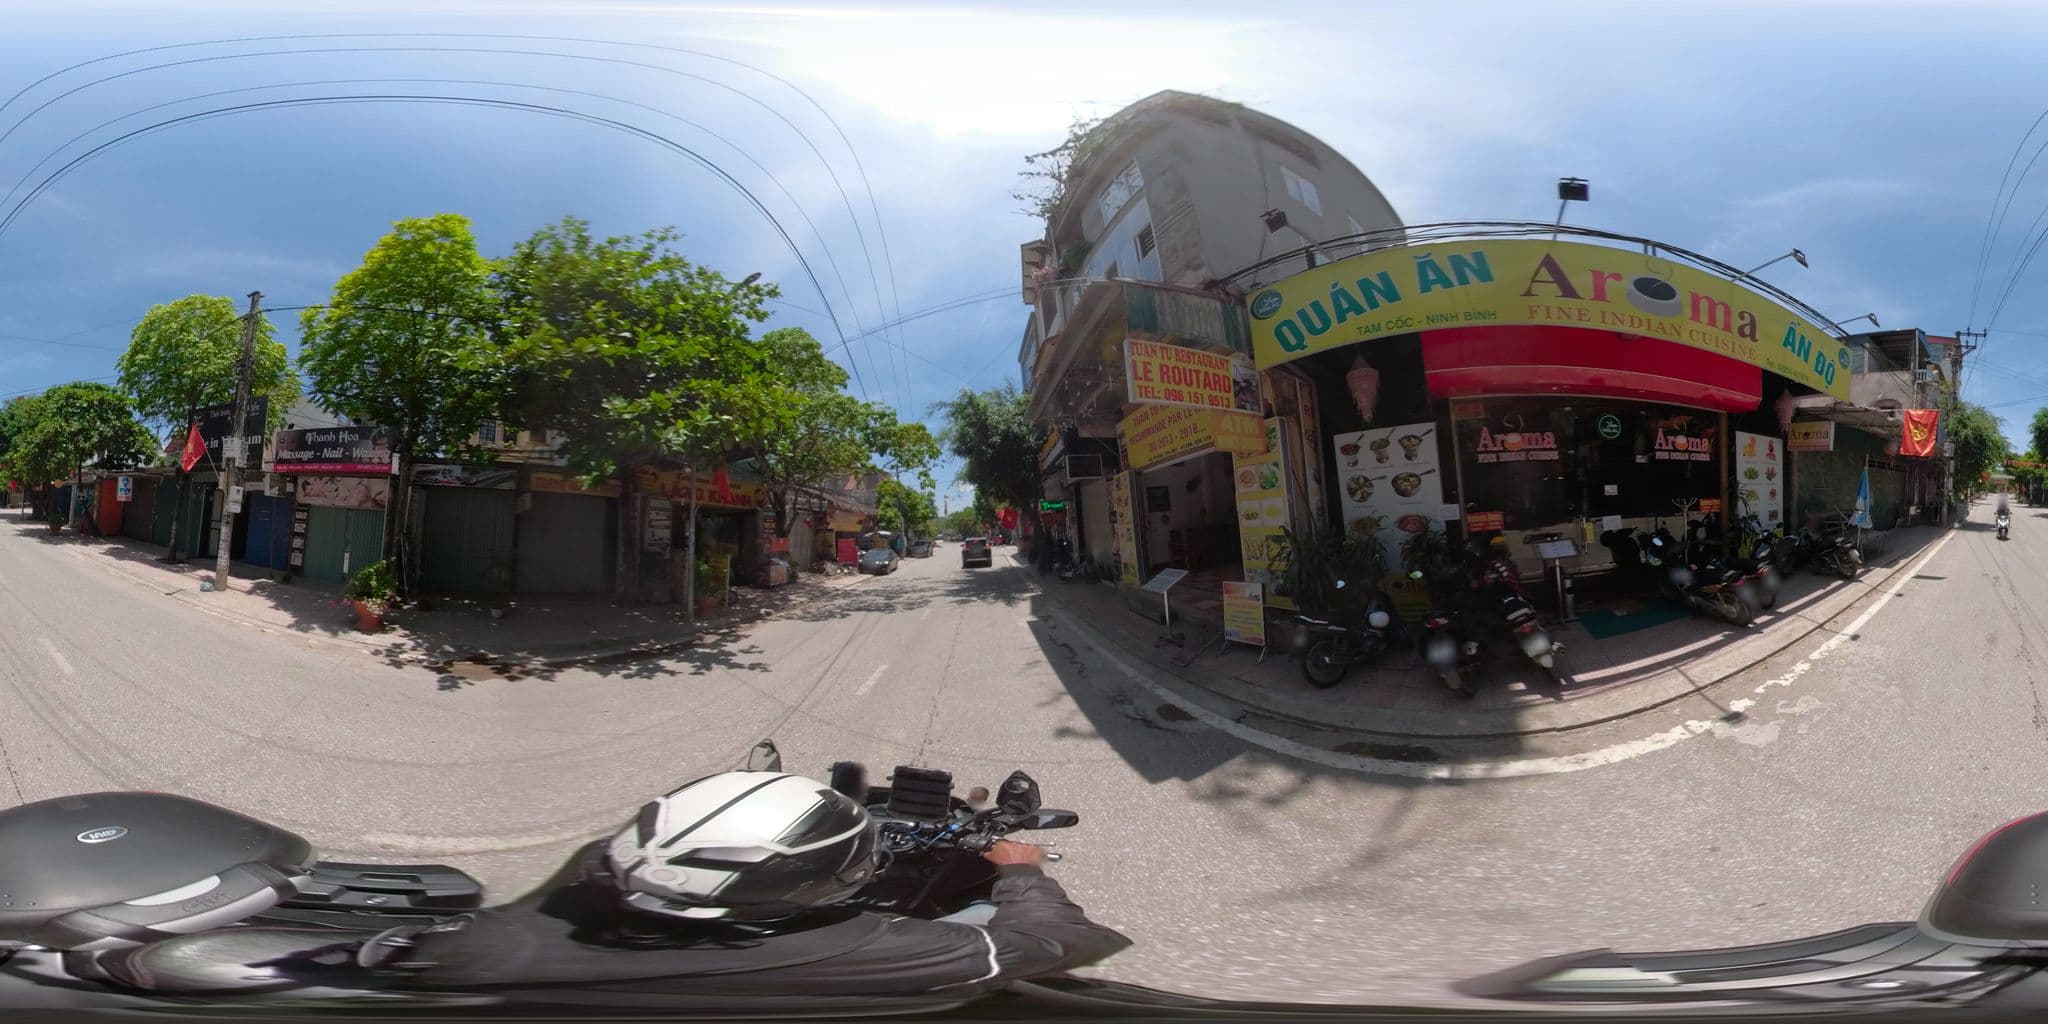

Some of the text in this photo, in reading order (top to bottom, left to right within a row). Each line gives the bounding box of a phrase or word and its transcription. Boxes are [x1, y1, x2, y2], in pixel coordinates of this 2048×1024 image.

[1273, 251, 1495, 353] QUÁN ĂN
[1519, 252, 1759, 343] Aroma
[1356, 322, 1381, 336] TAM
[1426, 313, 1459, 325] NINH
[1528, 304, 1757, 360] FINE INDIAN CUISINE
[1129, 341, 1157, 359] TUAN
[1159, 345, 1173, 360] TU
[1174, 348, 1229, 372] RESTAURANT
[1782, 321, 1812, 364] ẤN
[1814, 350, 1836, 389] ĐỘ
[1130, 359, 1153, 382] LE
[1159, 363, 1232, 394] ROUTARD
[1136, 384, 1161, 399] TEL:
[1222, 416, 1259, 434] ATM
[1789, 427, 1829, 440] Aroma
[305, 432, 336, 445] Thanh
[1477, 425, 1557, 451] Aroma
[1654, 427, 1710, 452] Aroma
[276, 449, 315, 461] Massage
[322, 447, 343, 458] Nail
